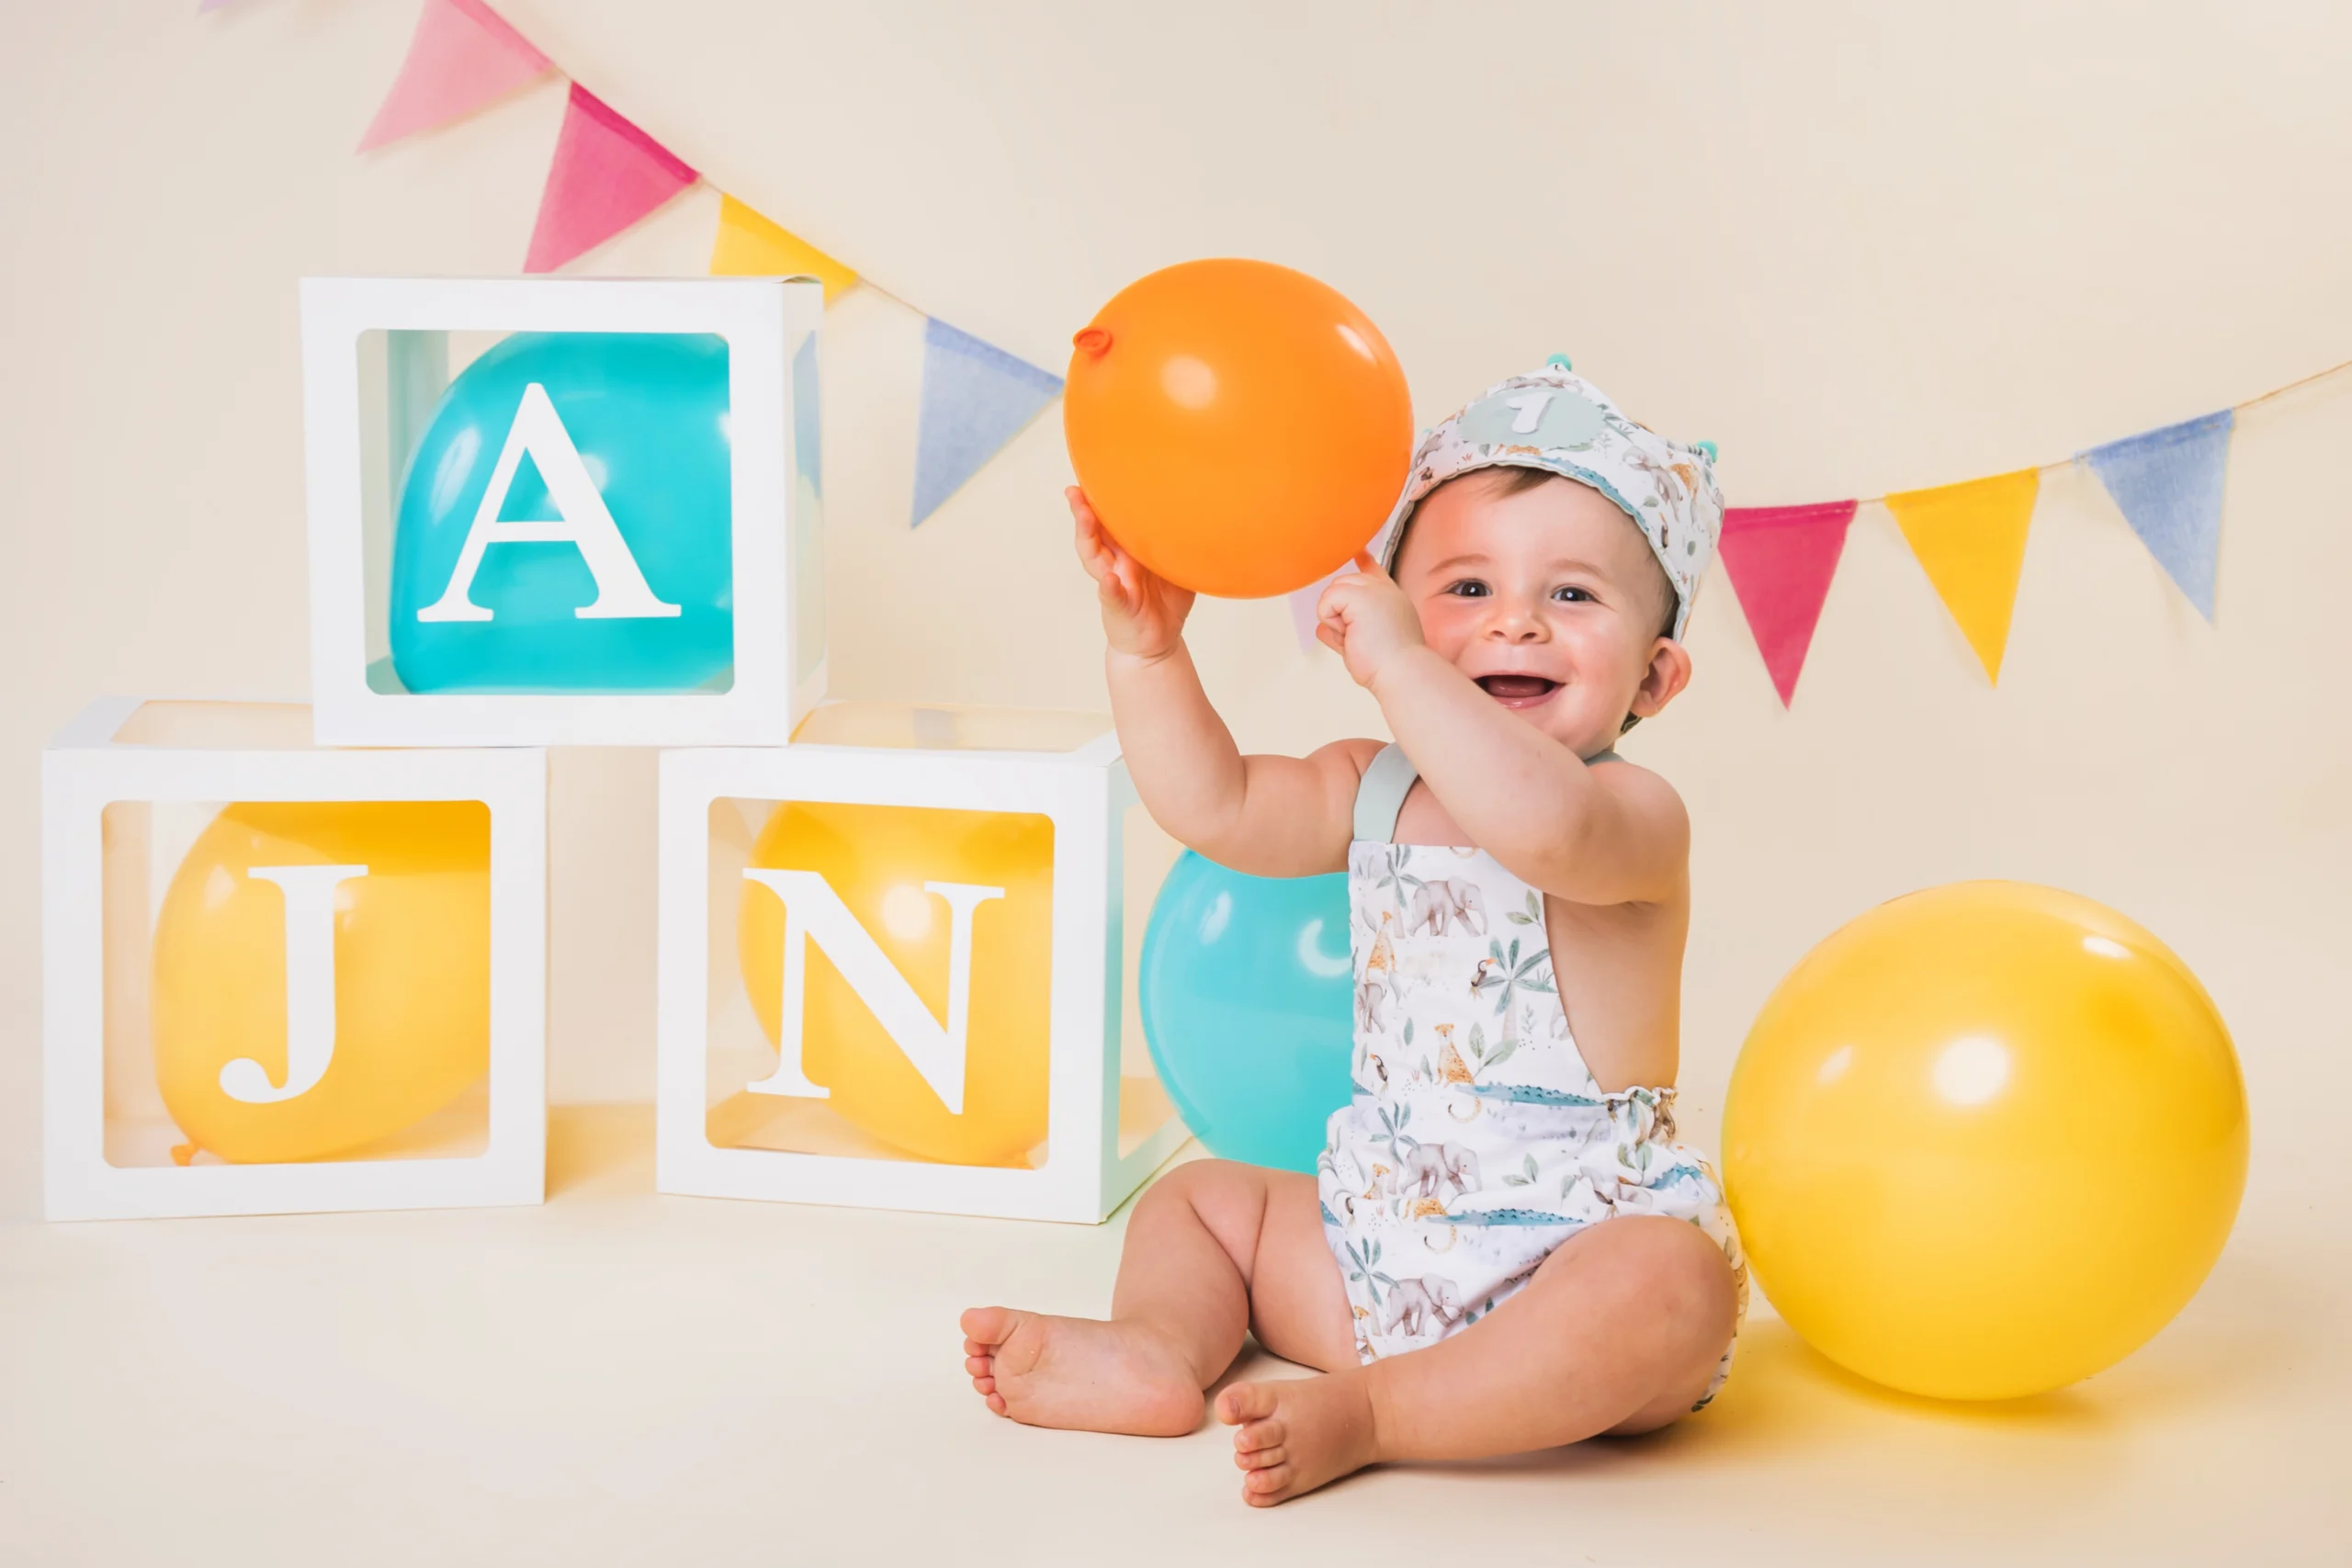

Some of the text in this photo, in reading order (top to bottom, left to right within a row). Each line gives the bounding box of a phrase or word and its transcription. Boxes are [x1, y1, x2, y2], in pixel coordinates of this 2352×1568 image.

[416, 382, 682, 623] A
[1506, 391, 1555, 434] 1
[219, 864, 369, 1104] J
[742, 867, 1006, 1115] N
